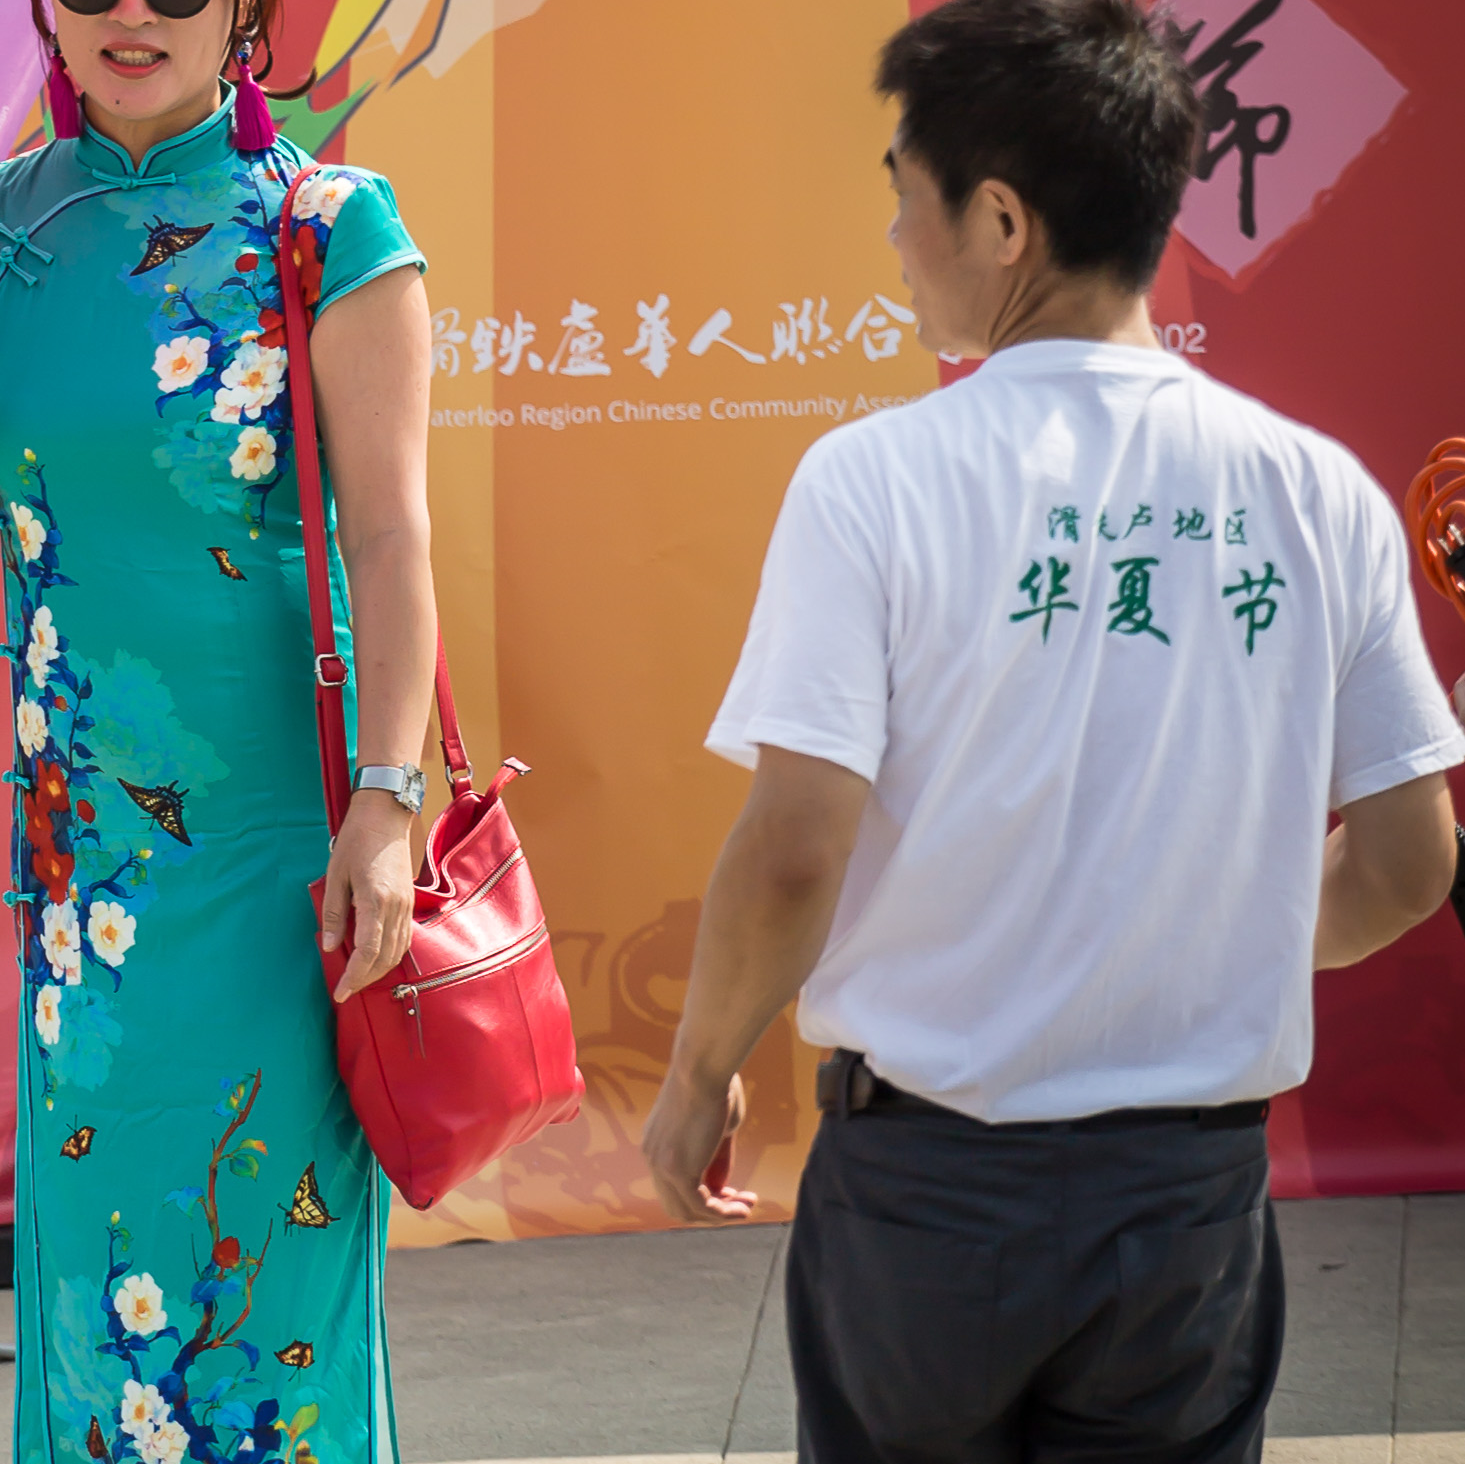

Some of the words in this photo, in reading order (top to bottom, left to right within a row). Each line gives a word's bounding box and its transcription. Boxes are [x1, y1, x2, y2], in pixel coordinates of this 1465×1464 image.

[430, 403, 515, 429] aterloo
[520, 403, 601, 431] Region
[608, 399, 702, 423] Chinese
[709, 394, 847, 422] Community
[1009, 556, 1286, 656] 华夏节
